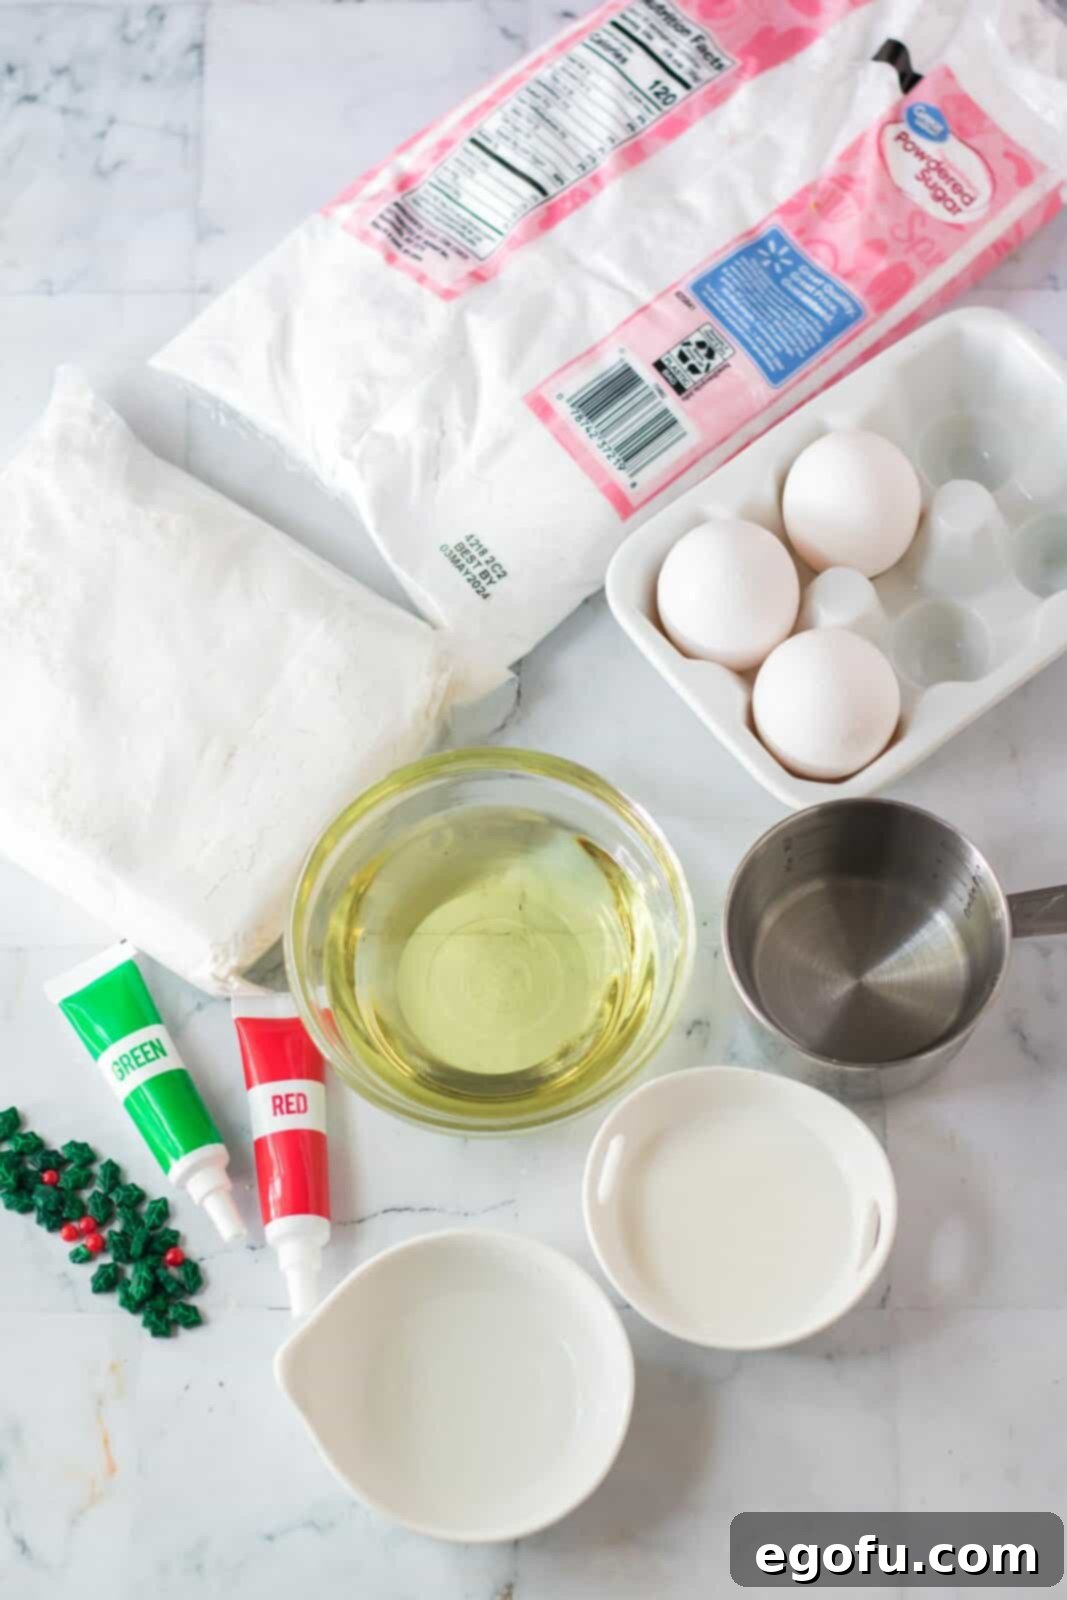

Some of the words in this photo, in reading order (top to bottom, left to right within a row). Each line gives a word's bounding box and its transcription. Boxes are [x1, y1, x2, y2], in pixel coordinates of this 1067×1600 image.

[690, 33, 725, 71] Facts
[648, 79, 677, 106] 120
[894, 131, 977, 207] Powdered
[914, 168, 963, 216] Sugar
[439, 543, 491, 600] 03MAY2024
[454, 541, 483, 569] BEST
[478, 569, 497, 586] BY
[465, 534, 488, 557] 4218
[484, 555, 508, 580] 2C2
[111, 1038, 168, 1082] GREEN
[271, 1093, 308, 1117] RED
